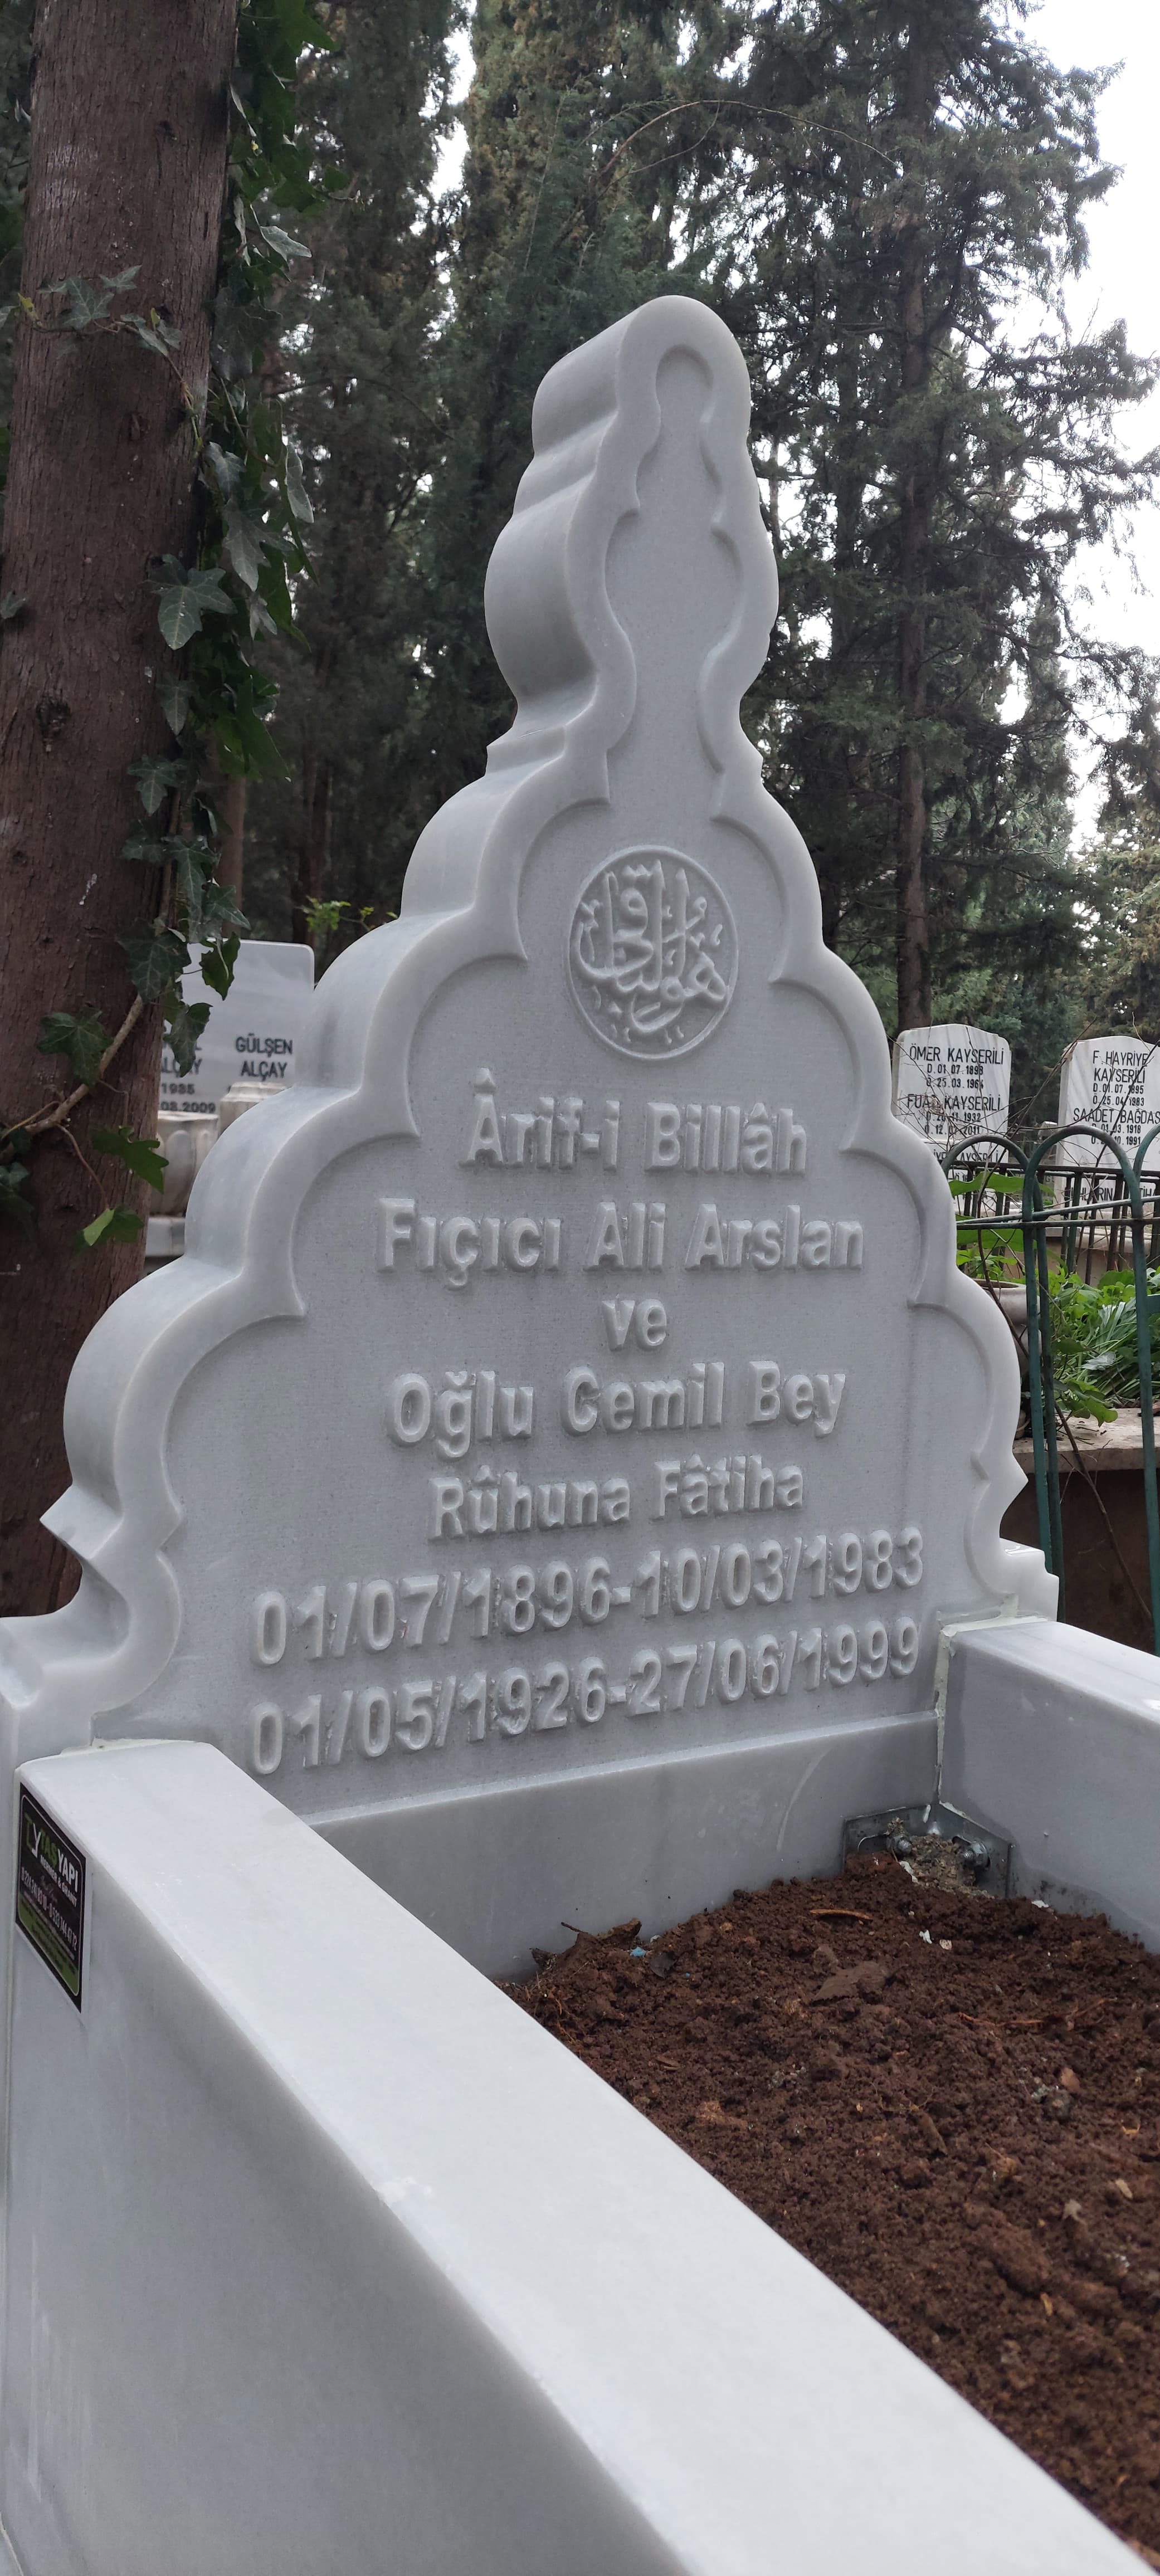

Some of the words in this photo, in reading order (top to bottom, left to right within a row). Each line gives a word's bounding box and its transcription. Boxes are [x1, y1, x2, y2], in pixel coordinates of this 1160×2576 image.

[236, 1033, 293, 1058] GÜLŞEN
[241, 1060, 287, 1082] ALÇAY
[910, 1043, 940, 1062] ÖMER
[948, 1047, 1004, 1065] KAYSERİLİ
[645, 1102, 807, 1175] Billâh
[1073, 1108, 1114, 1123] SAADET
[378, 1197, 561, 1289] Fıçıcı
[583, 1202, 666, 1270] Ali
[685, 1203, 863, 1270] Arslan
[601, 1299, 667, 1351] ve
[388, 1370, 534, 1458] Oğlu
[562, 1362, 725, 1435] Cemil
[747, 1360, 846, 1438] Bey
[429, 1464, 630, 1541] Rûhuna
[652, 1453, 804, 1520] Fâtiha
[252, 1526, 923, 1665] 01/07/1896-10/03/1983
[247, 1616, 918, 1775] 01/05/1926-27/06/1999
